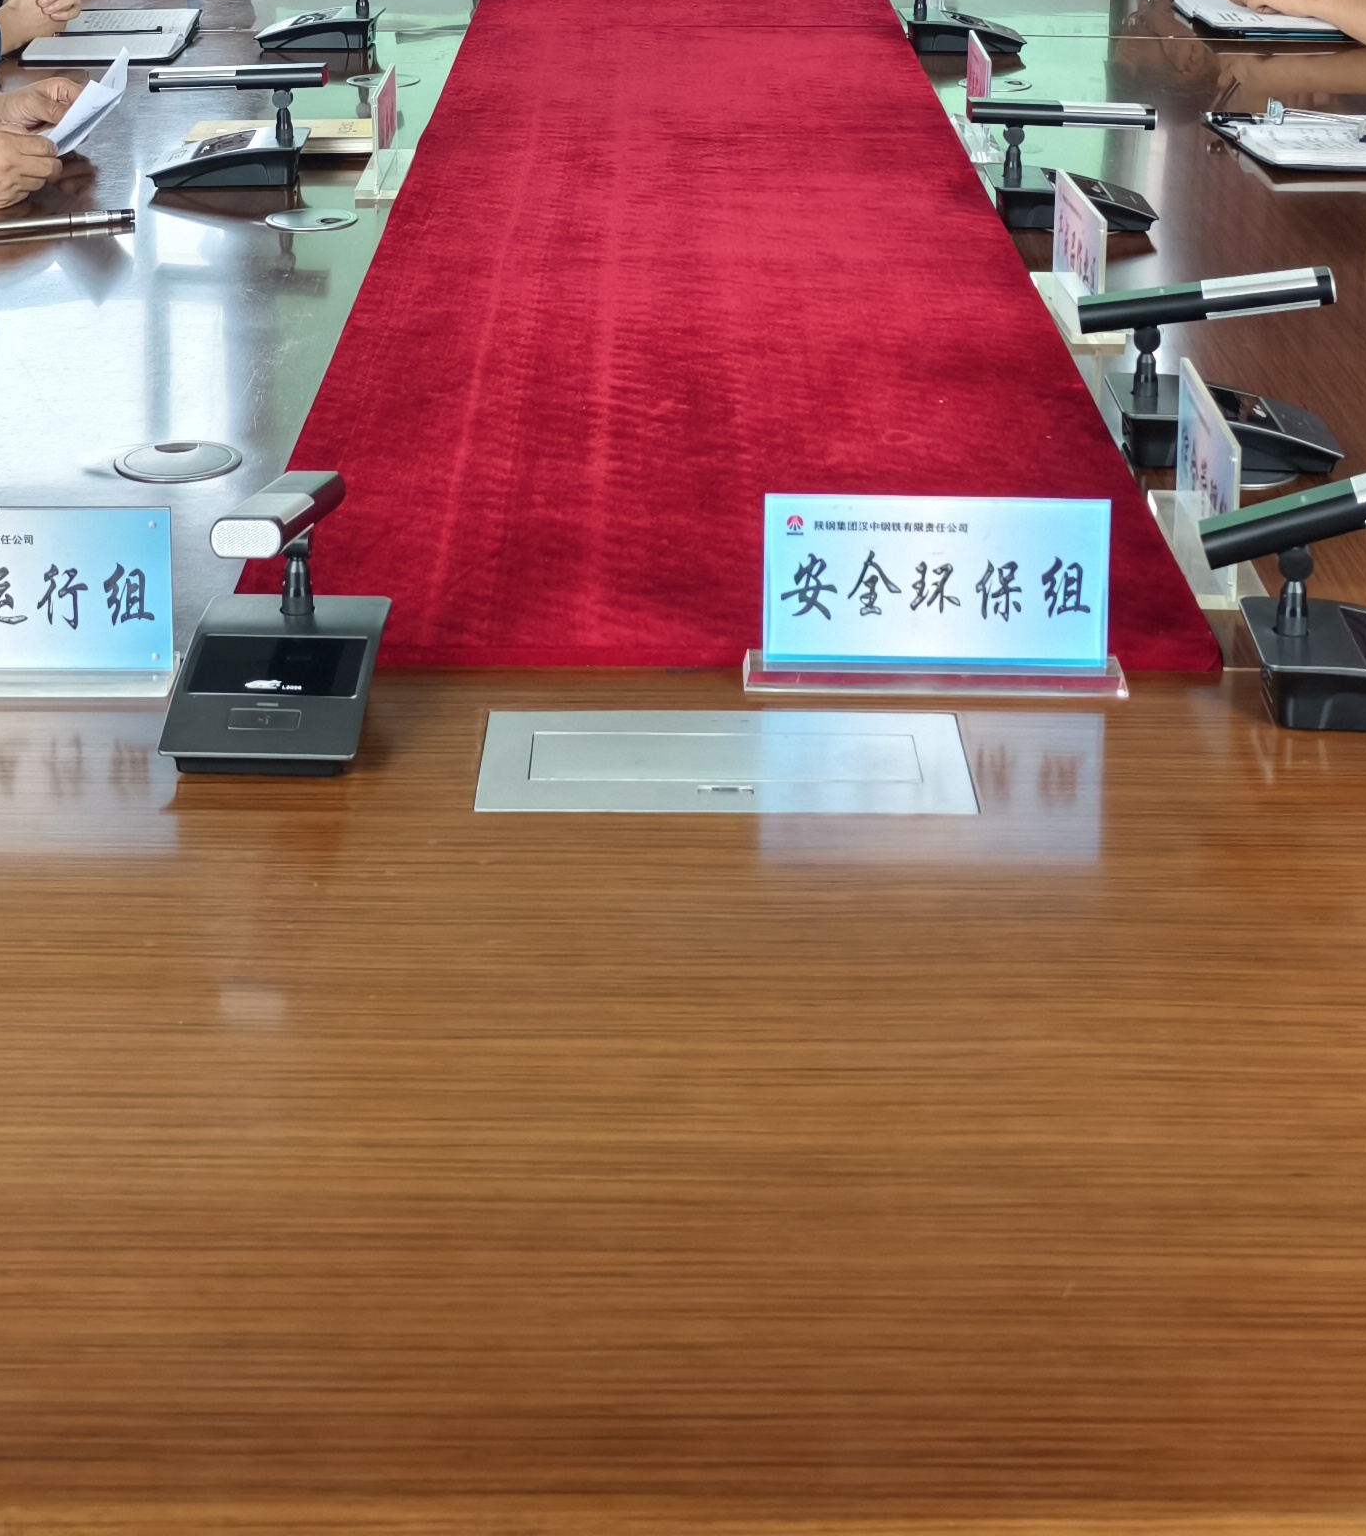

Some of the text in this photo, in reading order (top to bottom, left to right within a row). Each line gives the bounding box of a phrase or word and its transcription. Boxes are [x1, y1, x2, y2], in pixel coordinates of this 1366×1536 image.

[813, 520, 970, 535] 陕钢集团汉中钢铁有限责任公司
[780, 549, 1092, 622] 安全环保组
